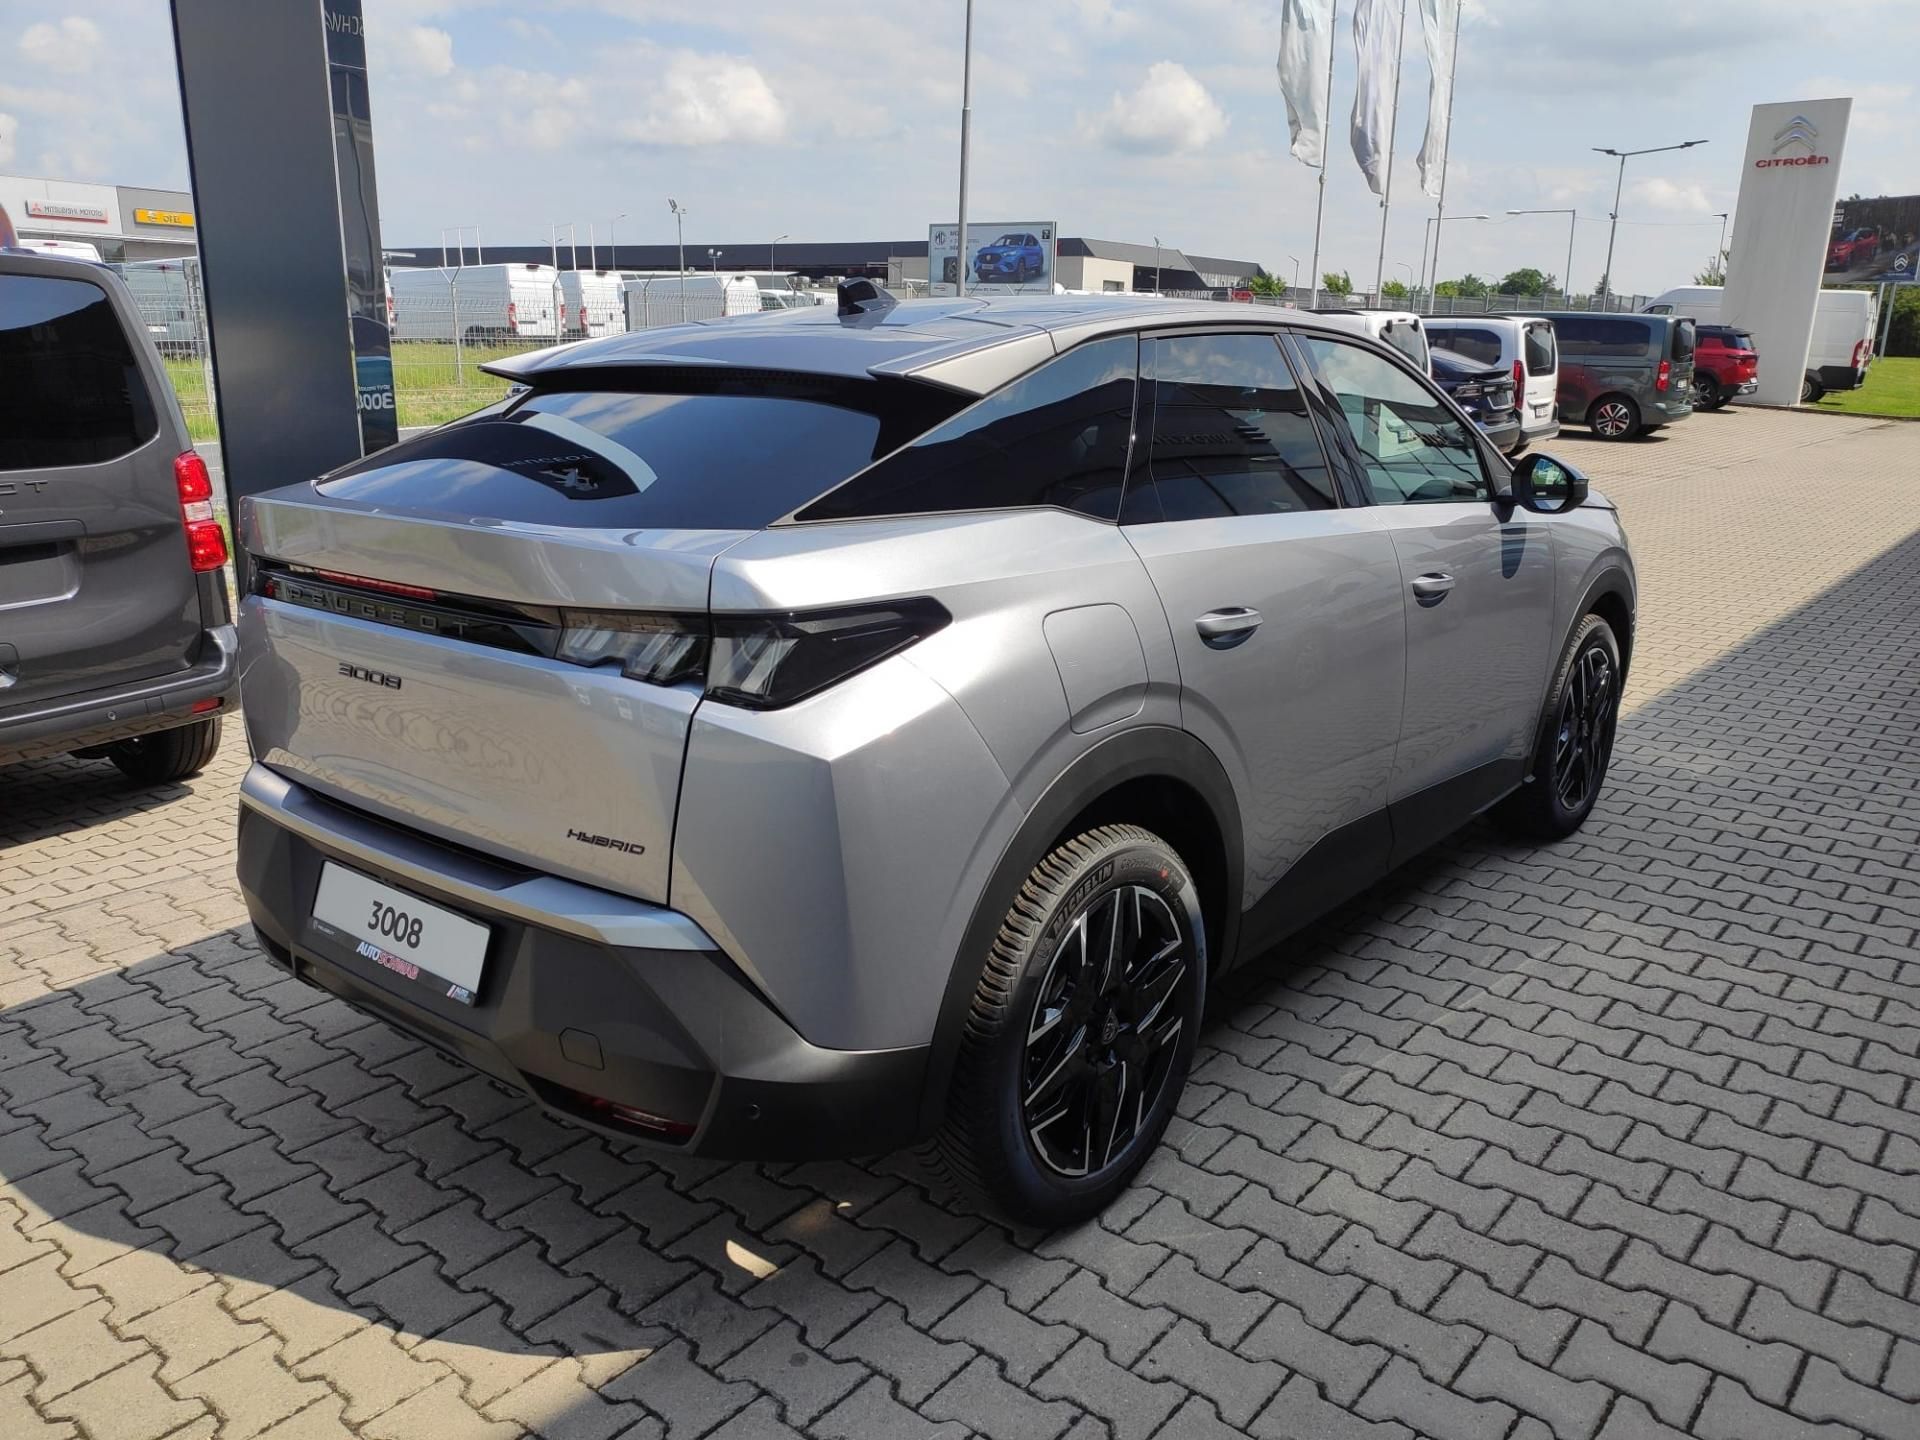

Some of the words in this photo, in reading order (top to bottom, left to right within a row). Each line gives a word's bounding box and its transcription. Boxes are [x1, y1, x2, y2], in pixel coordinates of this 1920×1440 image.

[287, 584, 469, 636] PEUGEOT
[338, 662, 402, 690] 3008
[567, 828, 645, 855] HYBRID
[1053, 863, 1113, 935] MICHELIN
[367, 900, 424, 949] 3008
